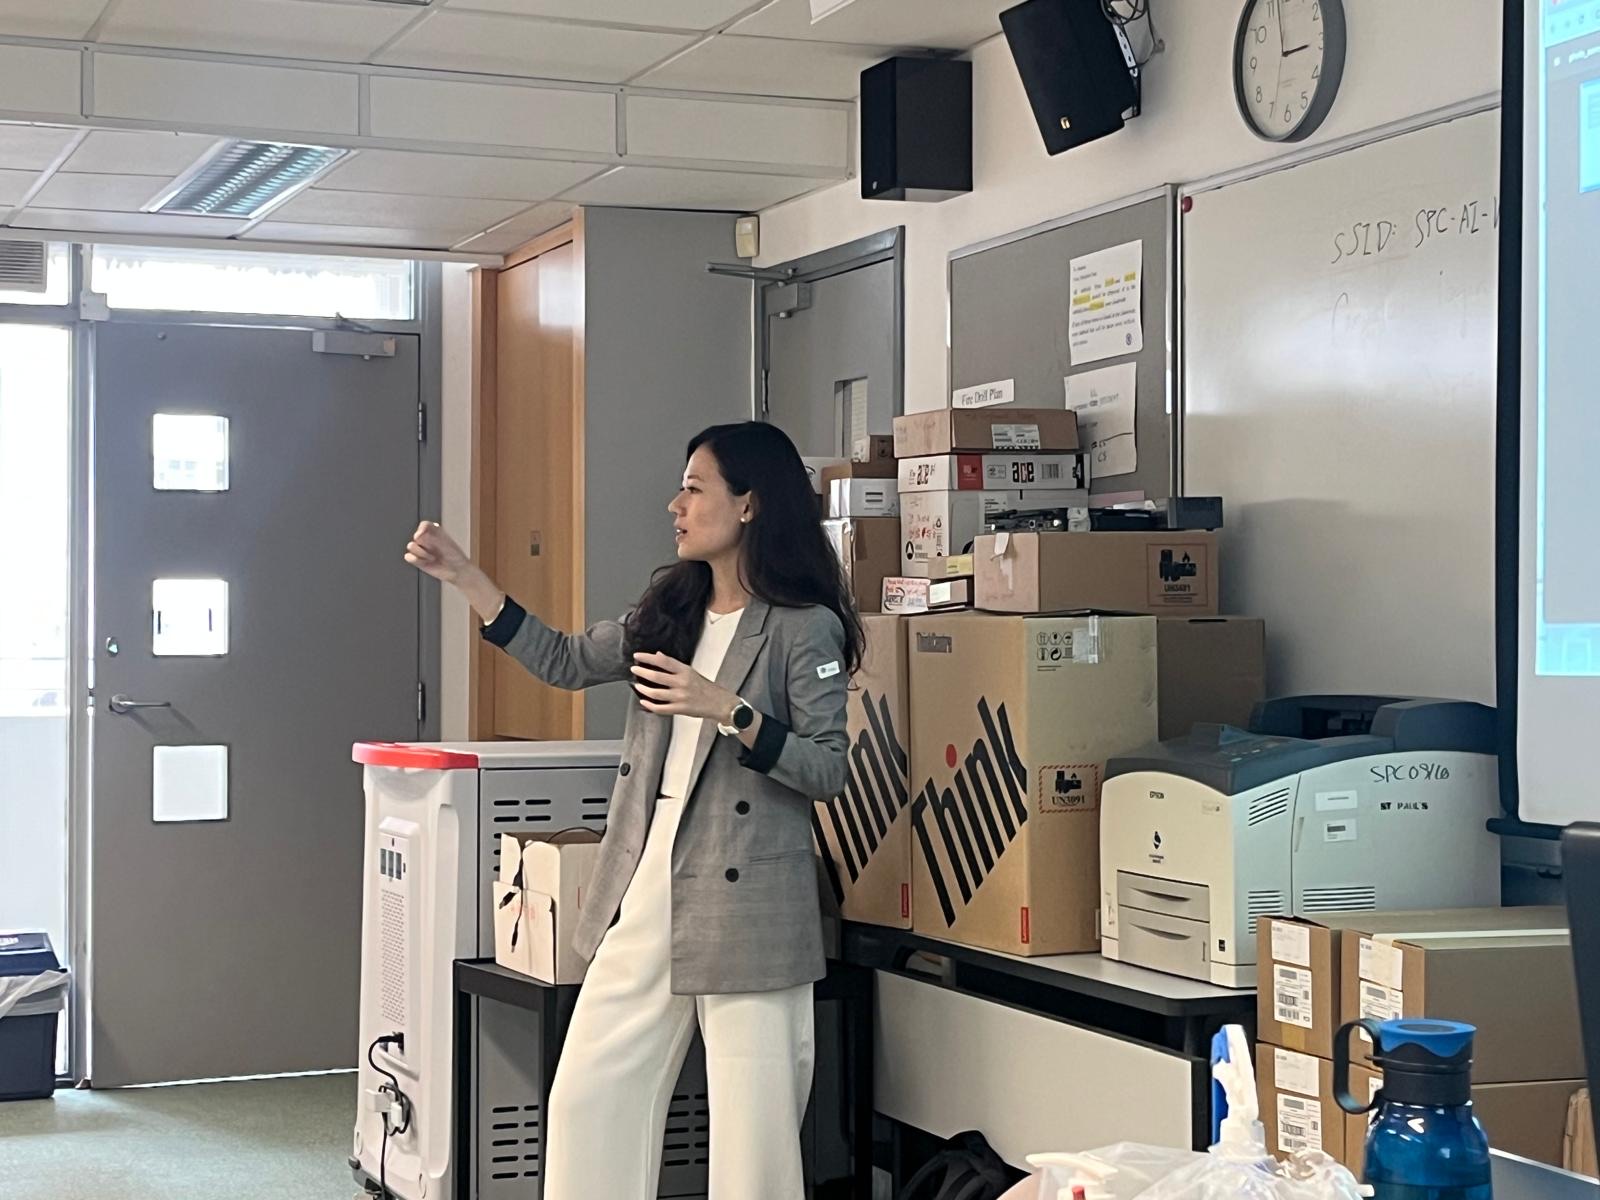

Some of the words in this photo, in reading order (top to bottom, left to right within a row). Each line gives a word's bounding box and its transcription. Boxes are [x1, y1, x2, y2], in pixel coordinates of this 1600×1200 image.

[1311, 3, 1319, 21] 2
[1249, 25, 1267, 44] 10
[1249, 56, 1257, 76] 9
[1311, 64, 1320, 80] 4
[1255, 85, 1263, 103] 8
[1300, 90, 1309, 110] 5
[1268, 101, 1275, 118] 7
[1283, 103, 1292, 123] 6
[1331, 220, 1397, 264] SSID:
[989, 388, 1003, 401] Plan
[1012, 461, 1035, 484] ace
